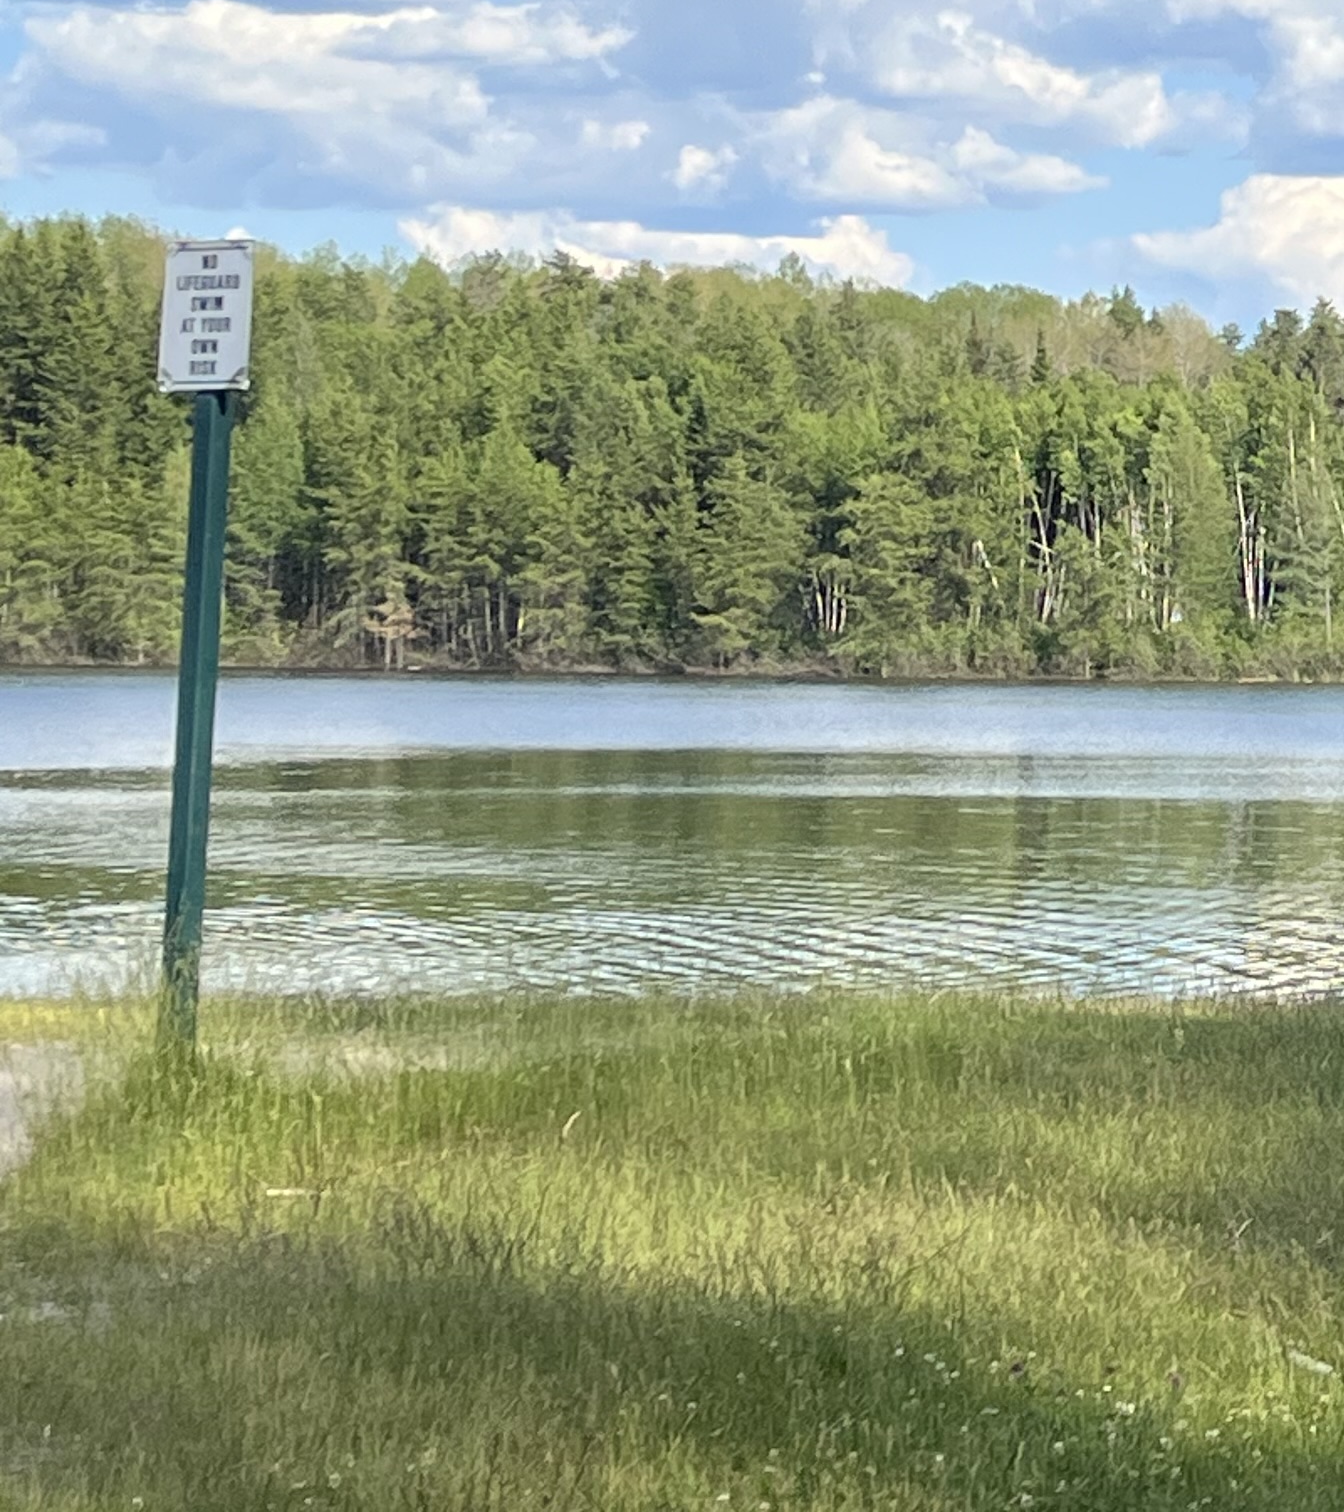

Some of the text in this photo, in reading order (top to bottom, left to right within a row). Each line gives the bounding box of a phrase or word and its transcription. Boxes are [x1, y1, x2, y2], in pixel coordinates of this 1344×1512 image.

[202, 254, 217, 269] NO
[176, 274, 240, 291] LIFEGUARD
[191, 296, 223, 312] SWIM
[180, 317, 231, 333] AT YOUR
[190, 339, 218, 354] OWN
[189, 360, 216, 375] RISK
